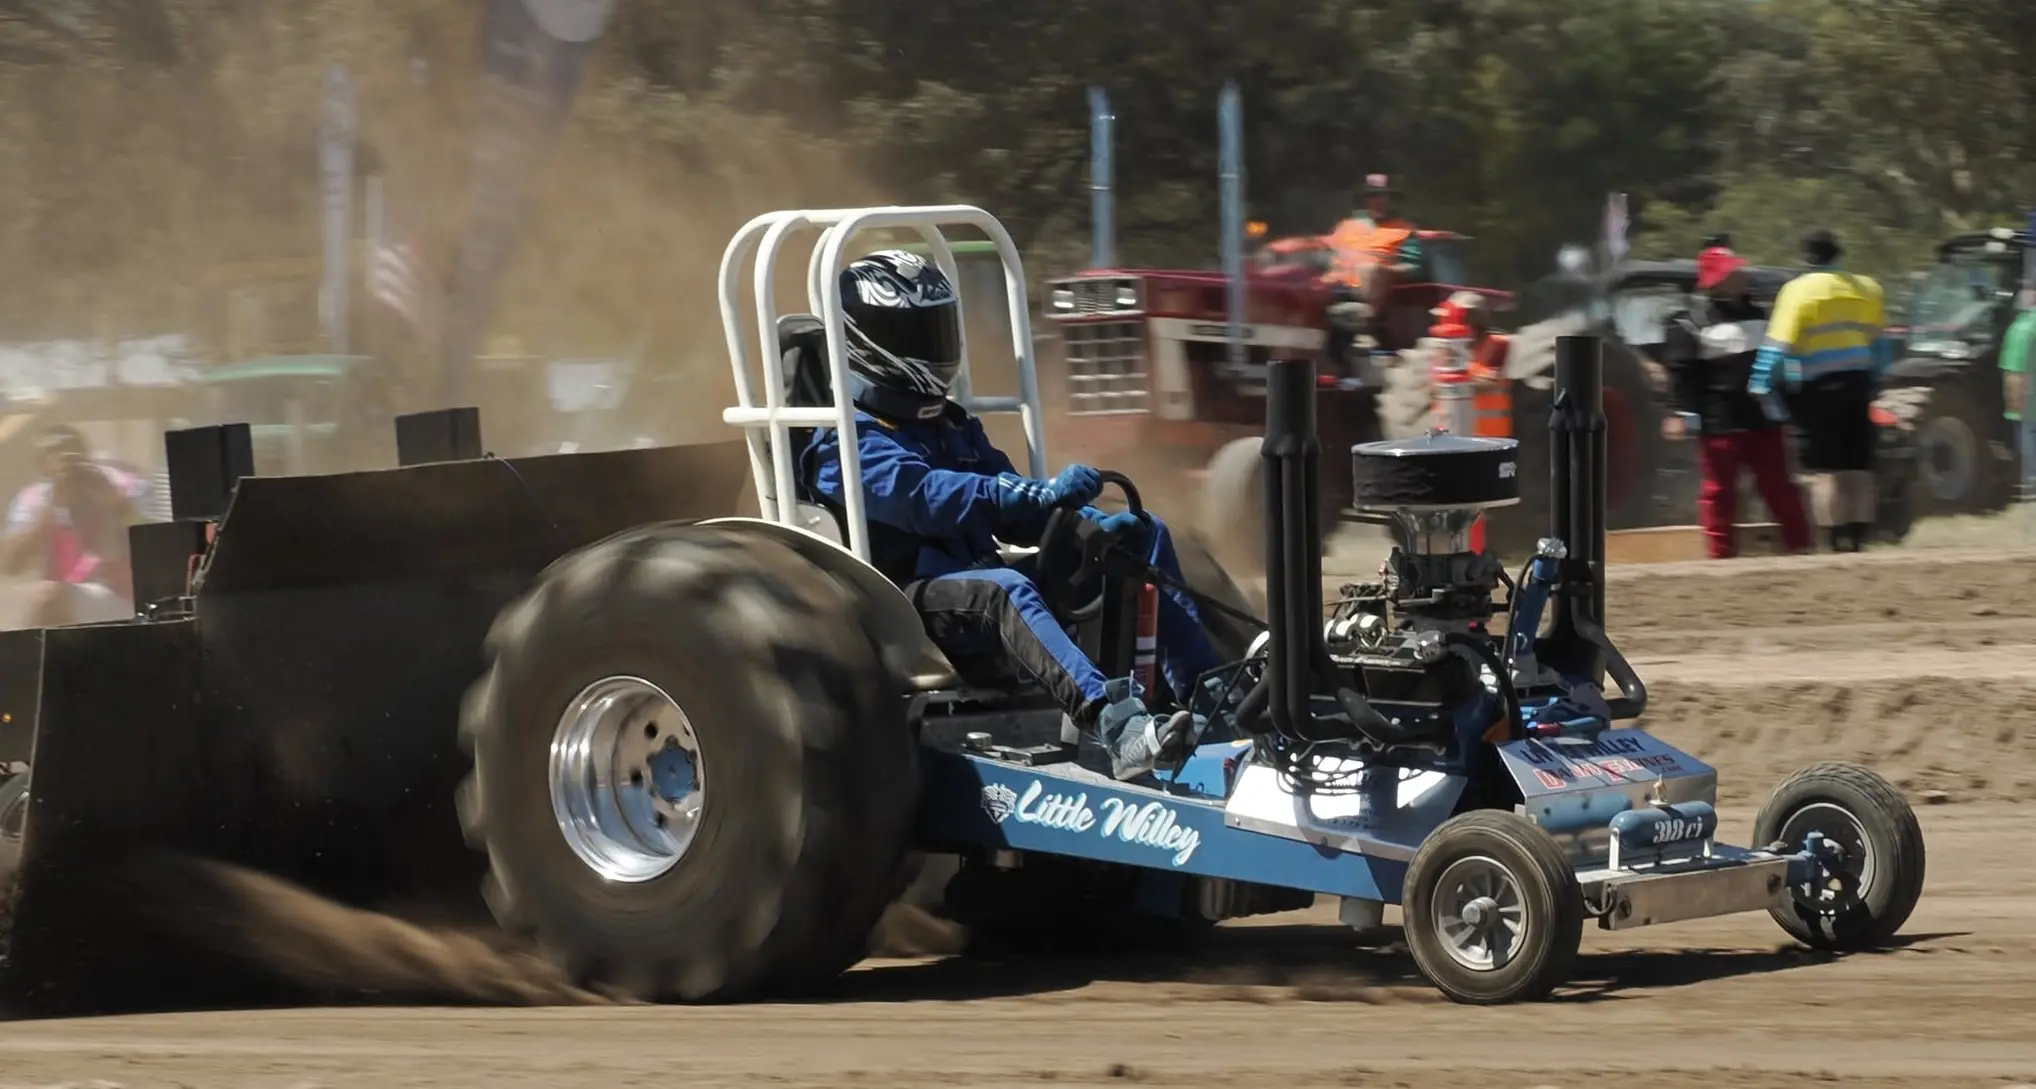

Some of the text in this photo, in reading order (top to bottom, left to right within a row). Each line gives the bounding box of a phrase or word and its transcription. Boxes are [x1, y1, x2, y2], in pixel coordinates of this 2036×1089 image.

[1015, 779, 1201, 867] Little Willey
[1652, 816, 1704, 844] 318 ci
